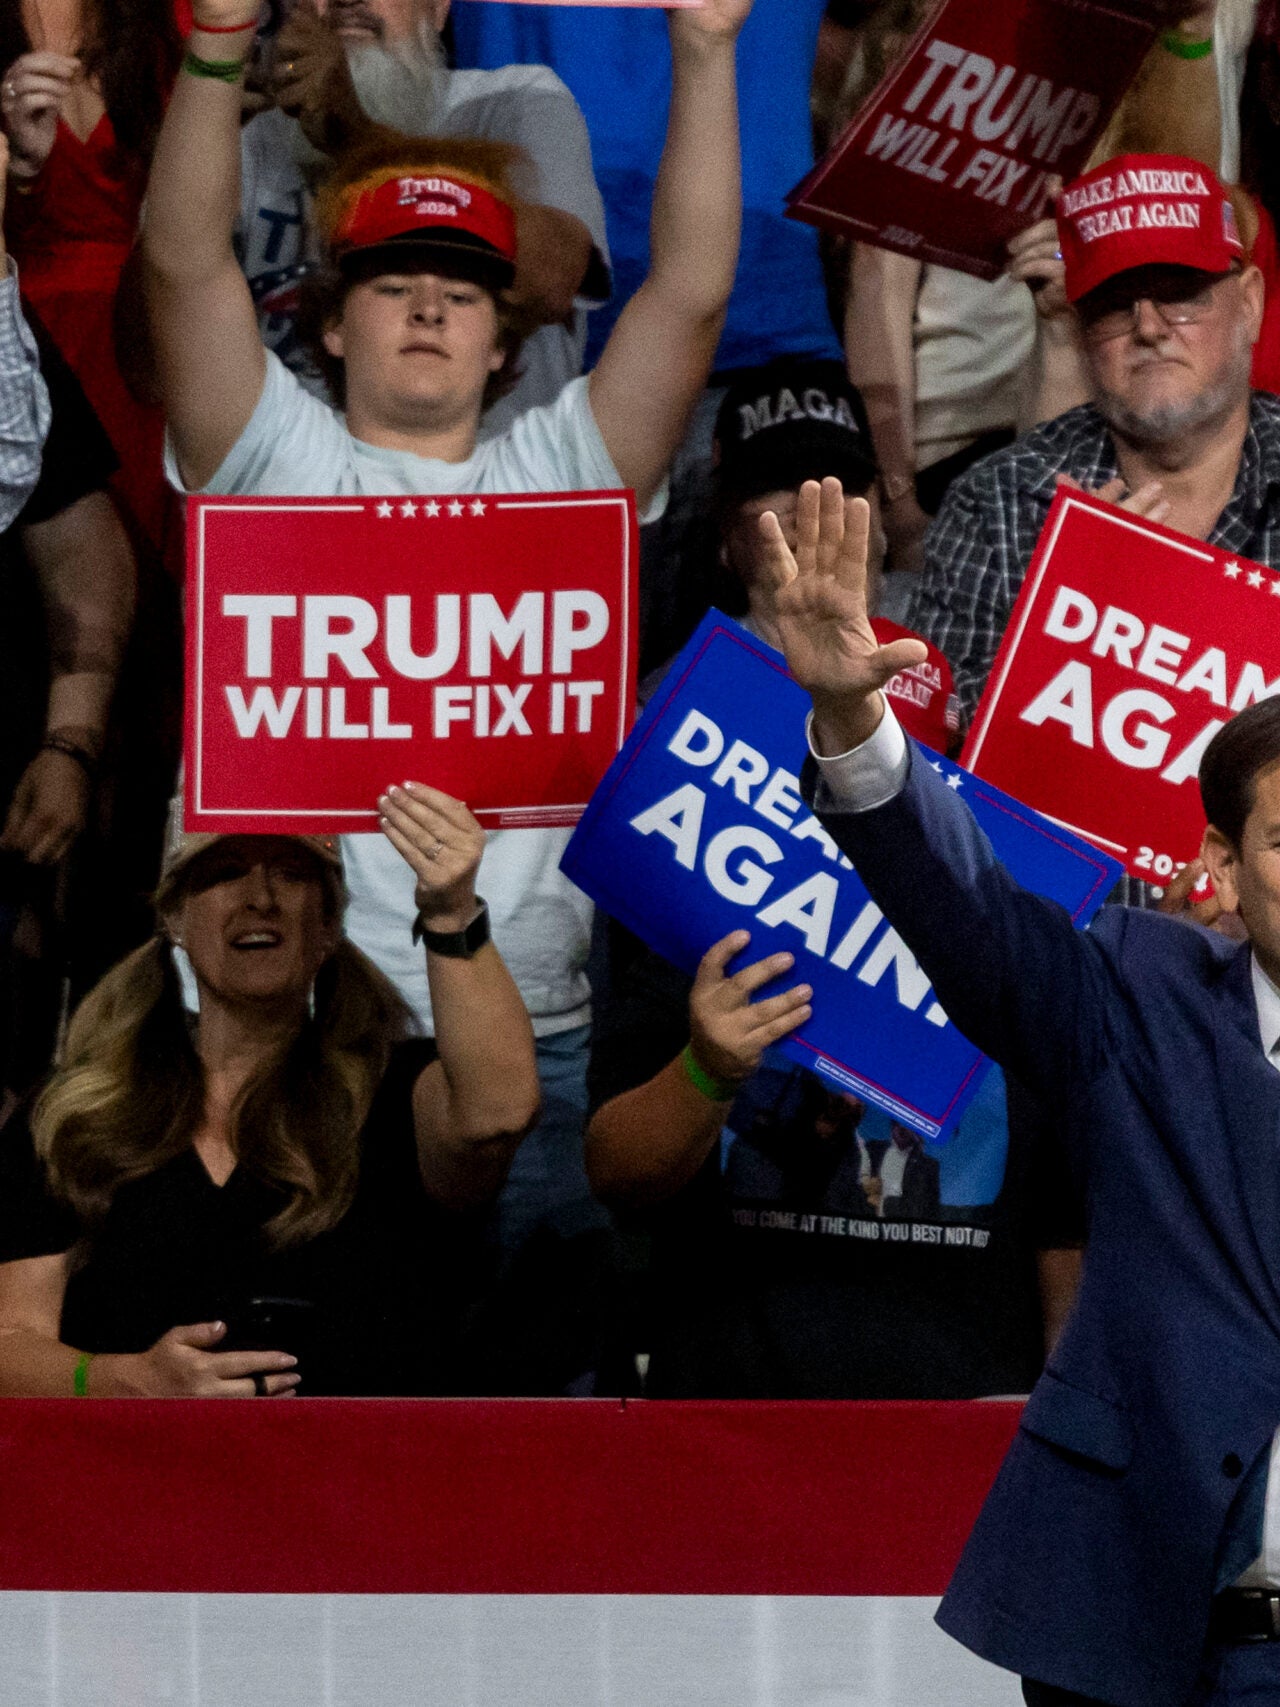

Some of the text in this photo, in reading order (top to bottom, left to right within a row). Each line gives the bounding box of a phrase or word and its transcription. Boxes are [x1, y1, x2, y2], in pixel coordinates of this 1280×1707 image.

[903, 39, 1099, 164] TRUMP
[865, 113, 960, 183] WILL
[953, 149, 1031, 207] FIX
[1064, 169, 1211, 217] MAKE AMERICA
[1136, 202, 1200, 228] AGAIN
[739, 388, 860, 440] MAGA
[222, 589, 610, 679] TRUMP
[225, 680, 605, 739] WILL FIX IT
[667, 708, 855, 871] DREA
[629, 782, 949, 1028] AGAIN
[759, 1210, 797, 1231] COME
[800, 1215, 818, 1233] AT
[820, 1216, 847, 1236] THE
[849, 1219, 880, 1240] KING
[881, 1222, 909, 1242] YOU
[911, 1224, 943, 1244] BEST
[945, 1227, 973, 1246] NOT
